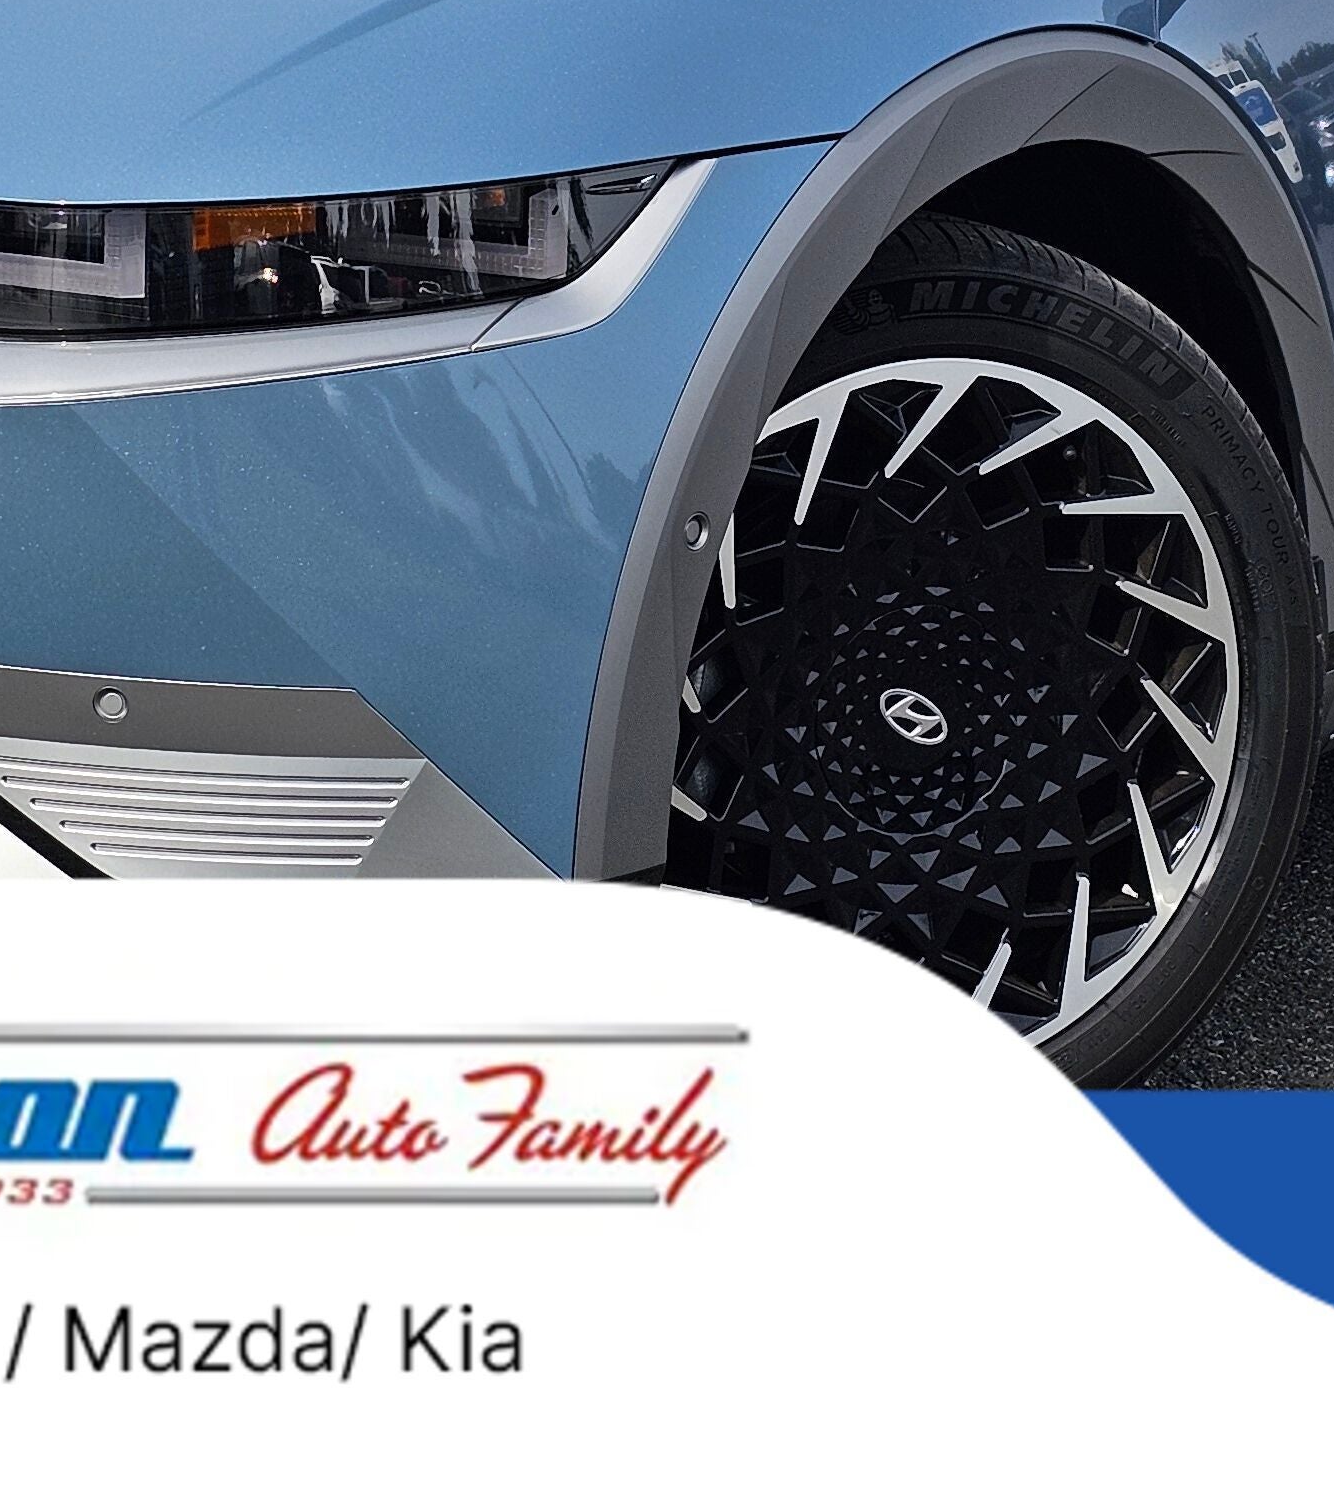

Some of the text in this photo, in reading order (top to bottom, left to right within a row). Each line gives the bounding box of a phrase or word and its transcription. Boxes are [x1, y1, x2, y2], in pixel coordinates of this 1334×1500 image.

[908, 280, 1182, 388] MICHELIN
[1201, 404, 1265, 494] PRIMACY
[1261, 502, 1290, 565] TOUR
